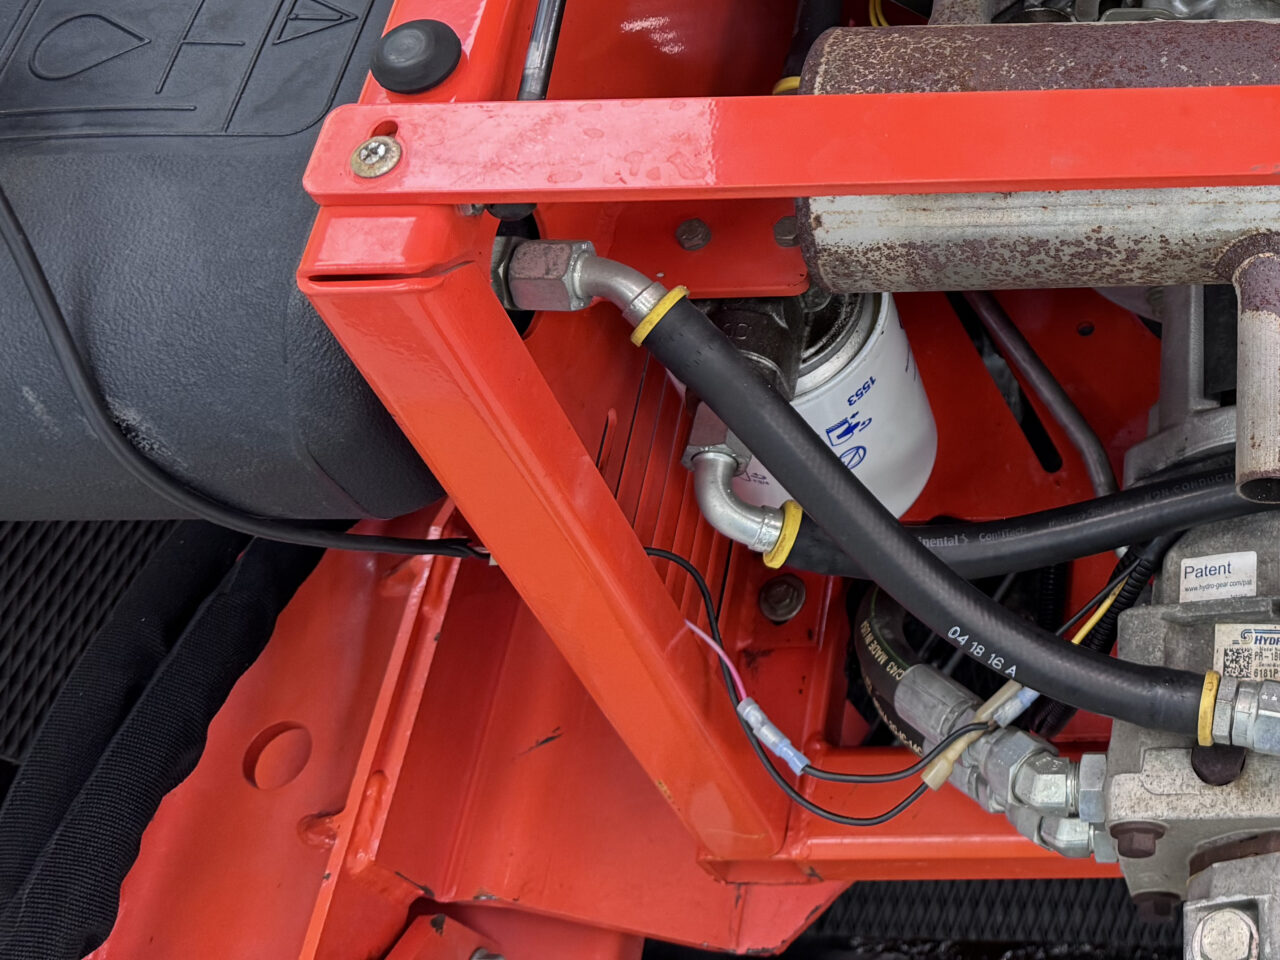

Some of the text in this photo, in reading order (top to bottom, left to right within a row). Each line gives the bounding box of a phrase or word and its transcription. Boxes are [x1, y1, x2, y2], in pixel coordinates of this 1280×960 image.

[847, 376, 876, 406] 1553
[917, 533, 959, 548] inental
[1184, 560, 1232, 579] Patent
[868, 640, 889, 665] MADE
[947, 625, 1017, 679] 04 18 16 A
